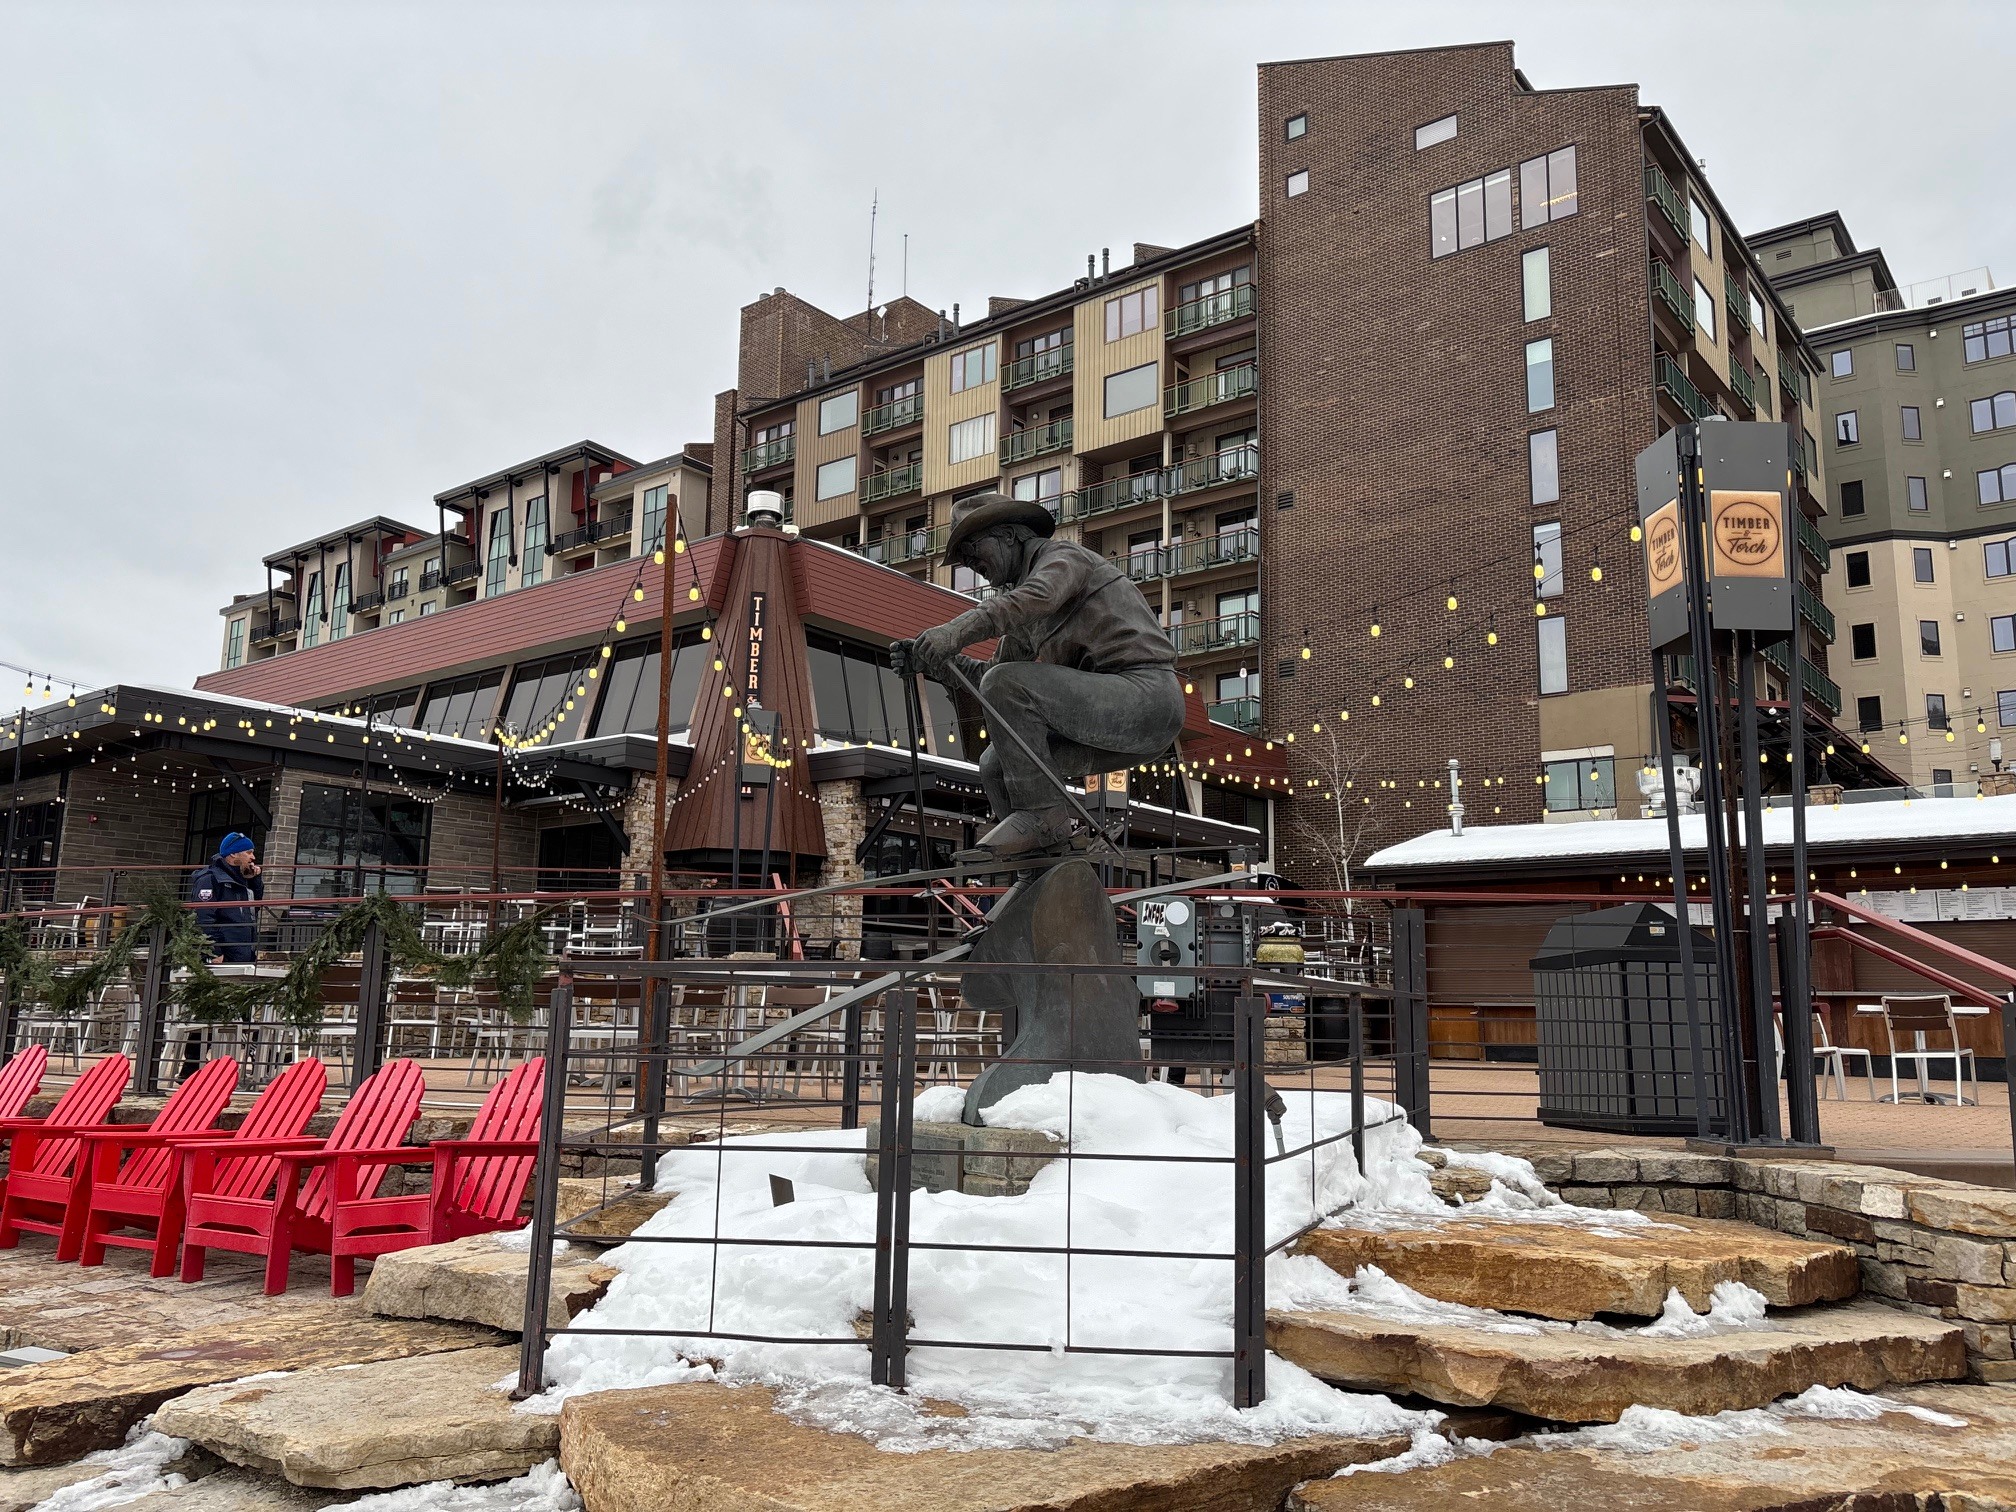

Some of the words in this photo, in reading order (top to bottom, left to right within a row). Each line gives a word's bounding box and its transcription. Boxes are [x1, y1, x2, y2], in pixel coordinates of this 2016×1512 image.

[1723, 517, 1770, 530] TIMBER
[1743, 529, 1751, 537] &
[1652, 528, 1675, 551] TIMBER
[1727, 537, 1768, 555] Torch
[1655, 549, 1674, 575] Torch
[749, 596, 763, 690] TIMBER
